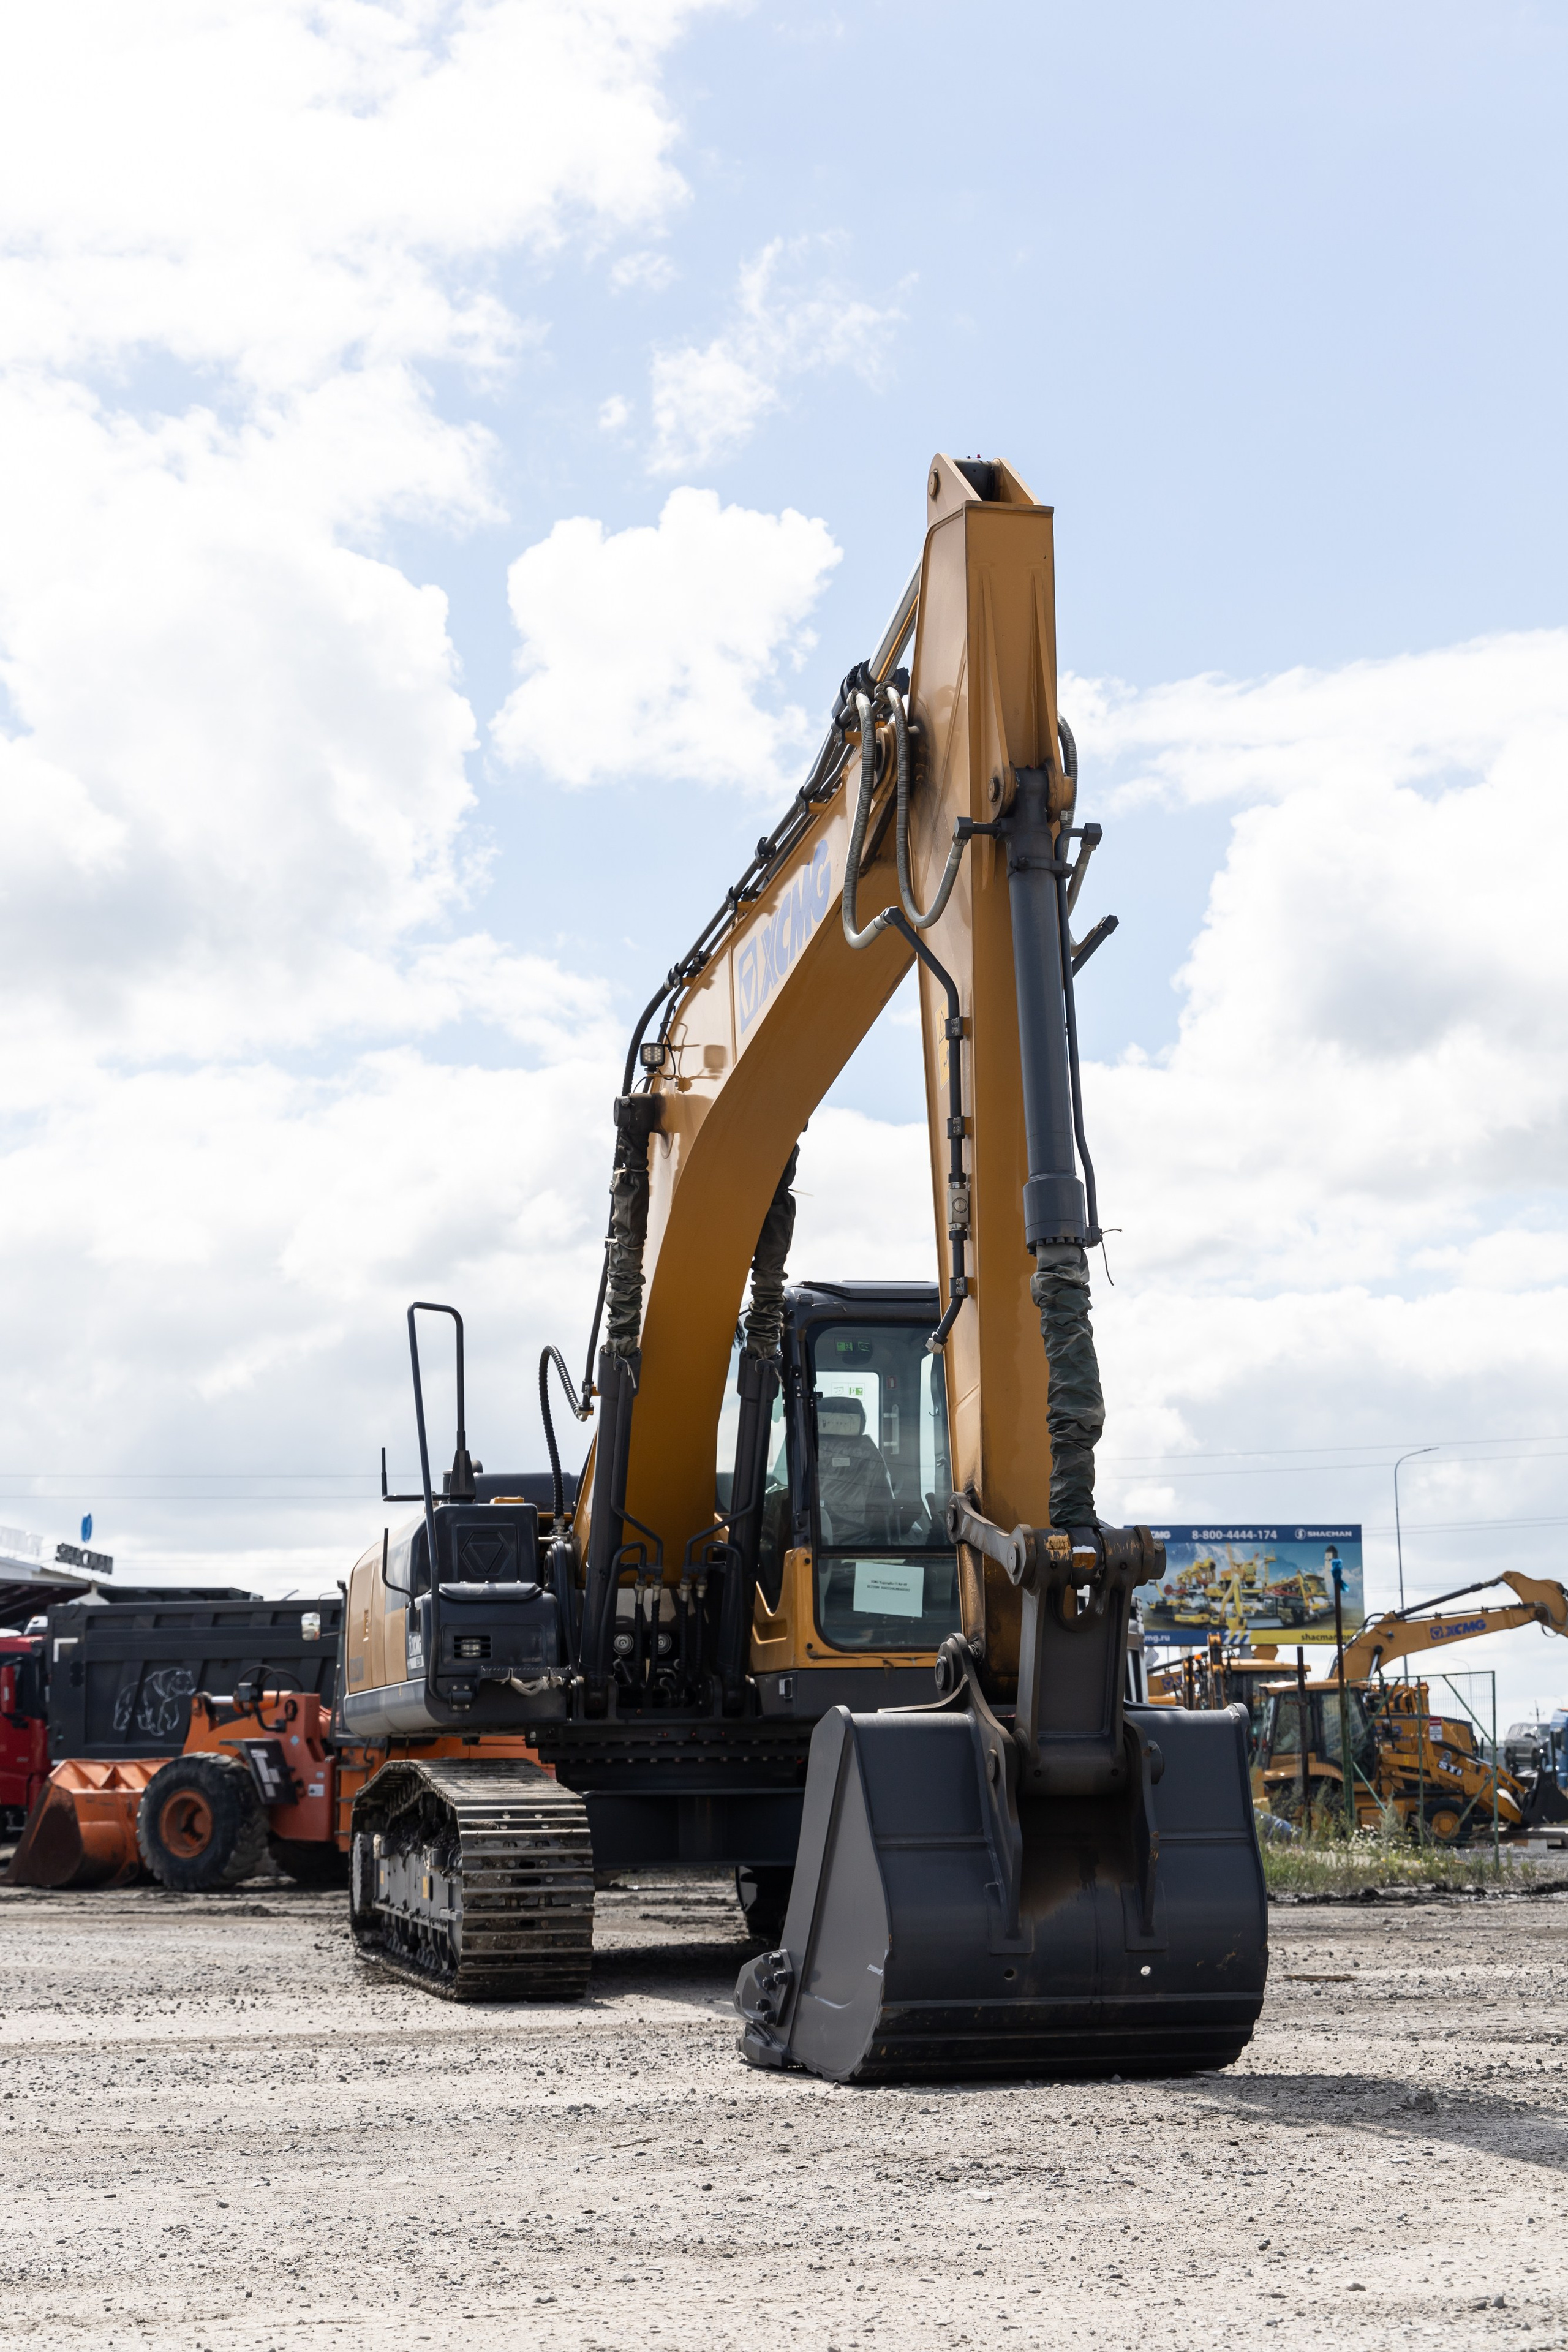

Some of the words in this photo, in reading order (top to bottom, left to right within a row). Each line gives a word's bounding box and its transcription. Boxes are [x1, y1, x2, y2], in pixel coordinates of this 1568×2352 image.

[758, 839, 831, 1008] XCMG
[1150, 1530, 1171, 1539] CMG
[1191, 1529, 1278, 1540] 8-800-4444-174
[56, 1542, 113, 1575] SHACMAN
[1445, 1619, 1486, 1637] XCMG
